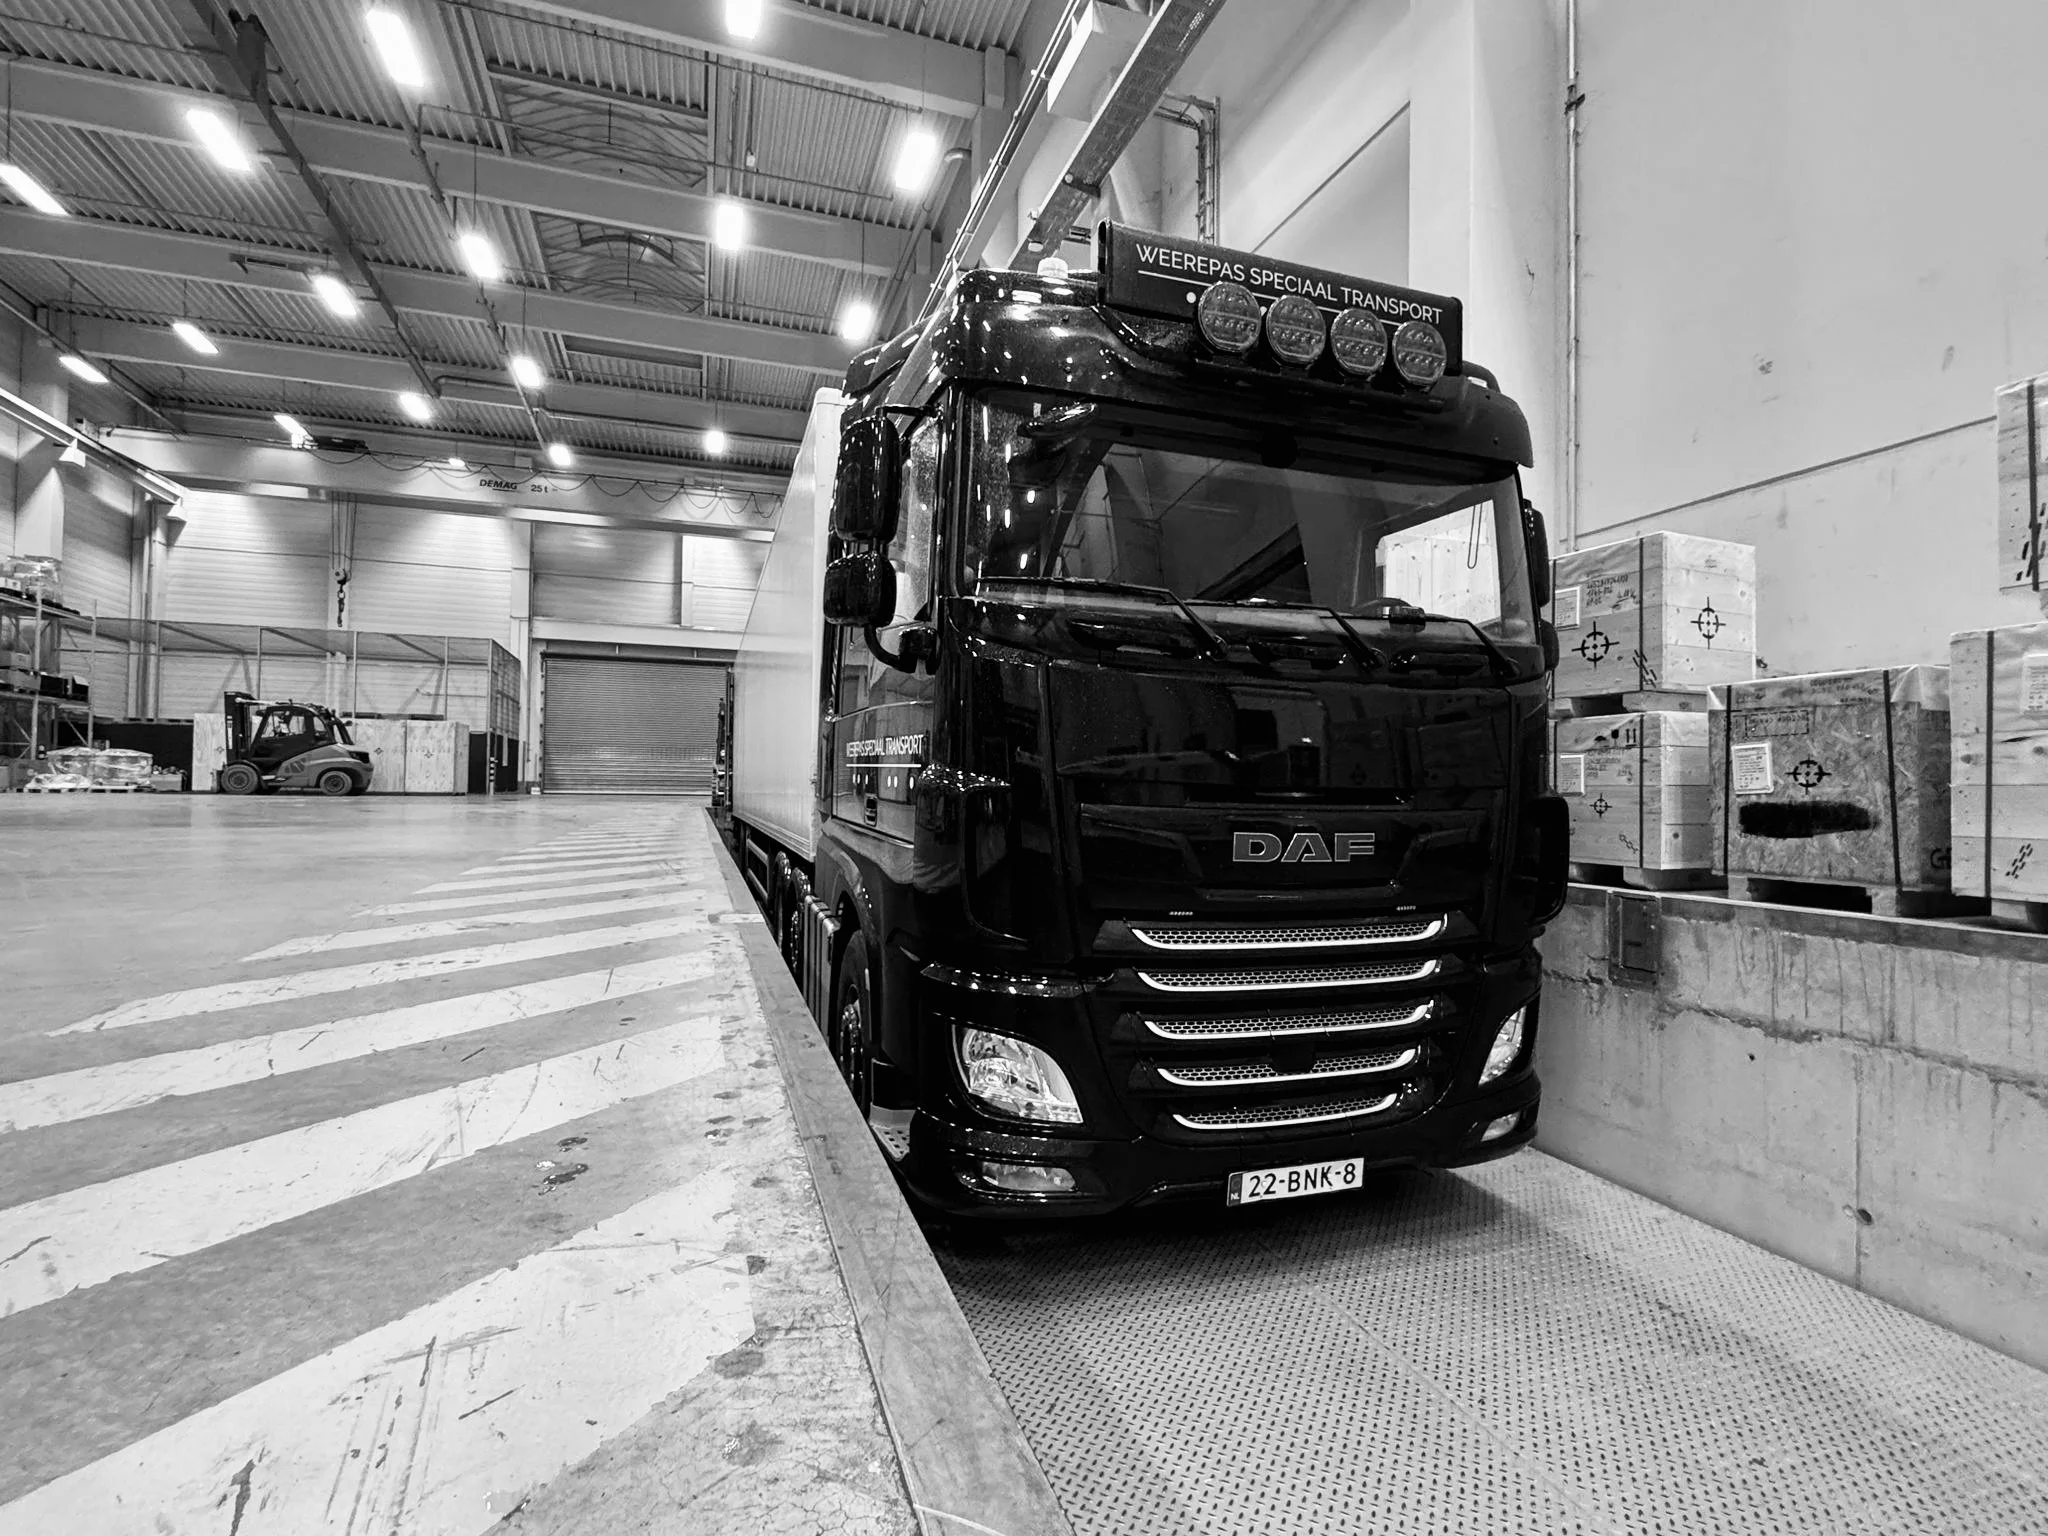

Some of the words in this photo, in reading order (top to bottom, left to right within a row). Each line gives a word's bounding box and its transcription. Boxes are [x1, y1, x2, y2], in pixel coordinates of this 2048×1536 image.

[1136, 244, 1245, 281] WEEREPAS
[1250, 267, 1337, 301] SPECIAAL
[1340, 286, 1443, 325] TRANSPORT
[479, 479, 518, 490] DEMAG
[885, 734, 924, 755] TRANSPORT
[1232, 832, 1375, 862] DAF
[1230, 1192, 1240, 1201] NL
[1248, 1162, 1356, 1198] 22-BNK-8
